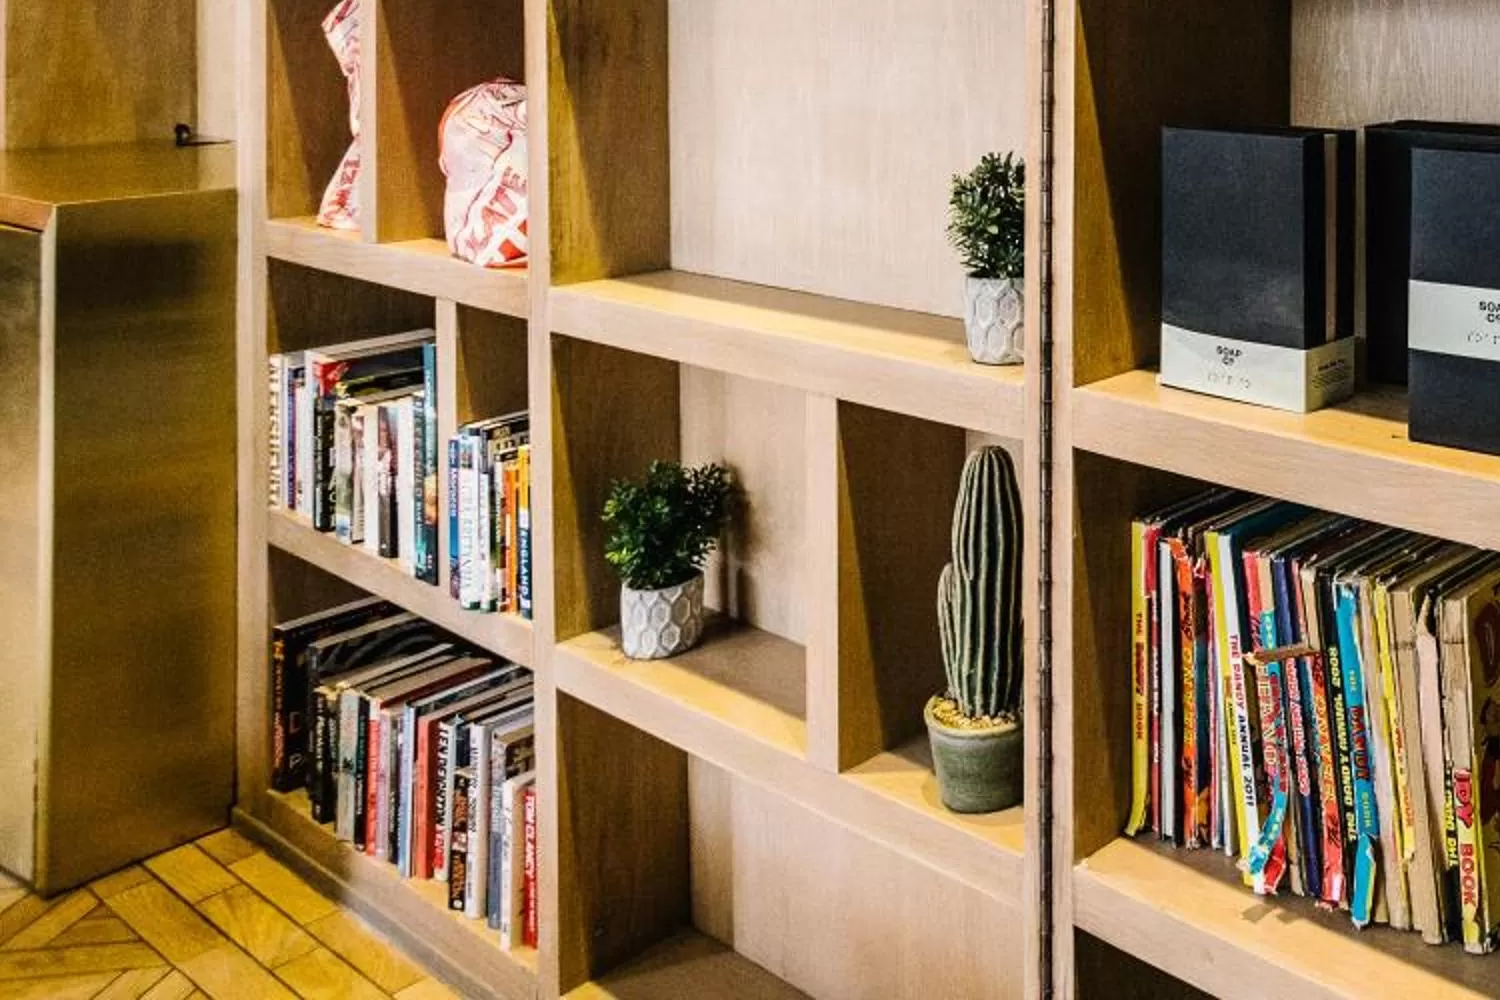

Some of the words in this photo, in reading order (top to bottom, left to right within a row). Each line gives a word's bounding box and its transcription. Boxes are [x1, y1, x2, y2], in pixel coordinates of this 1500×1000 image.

[1216, 345, 1243, 359] SOAP
[519, 529, 529, 597] ENGLAND
[1135, 611, 1144, 636] THE
[1228, 633, 1242, 659] THE
[1329, 646, 1341, 688] 2008
[1231, 663, 1246, 710] DANDY
[438, 728, 448, 753] LEN
[1237, 714, 1251, 770] ANNUAL
[1334, 694, 1348, 751] ANNUAL
[1350, 705, 1370, 781] DANDY
[1242, 775, 1255, 807] 2011
[1340, 753, 1354, 807] DANDY
[525, 795, 534, 823] TOM
[1347, 812, 1357, 842] THE
[525, 825, 535, 879] CLANCY
[1459, 843, 1476, 907] BOOK
